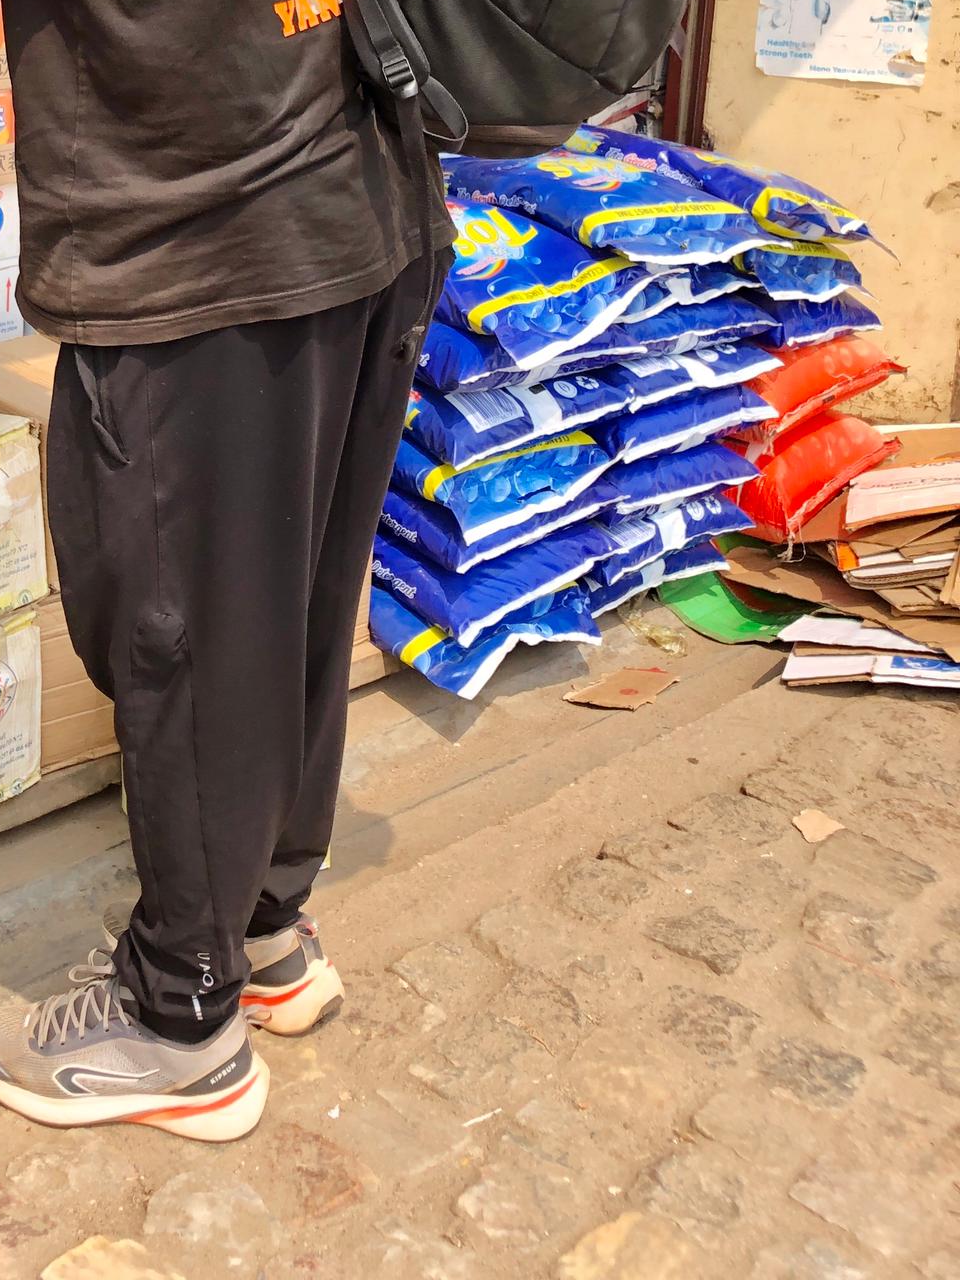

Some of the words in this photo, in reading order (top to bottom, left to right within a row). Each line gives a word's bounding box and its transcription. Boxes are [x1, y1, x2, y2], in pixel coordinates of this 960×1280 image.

[759, 48, 788, 59] Strong
[789, 51, 813, 60] Teeth
[370, 560, 417, 600] Detergent
[209, 1060, 238, 1086] KIPRUN
